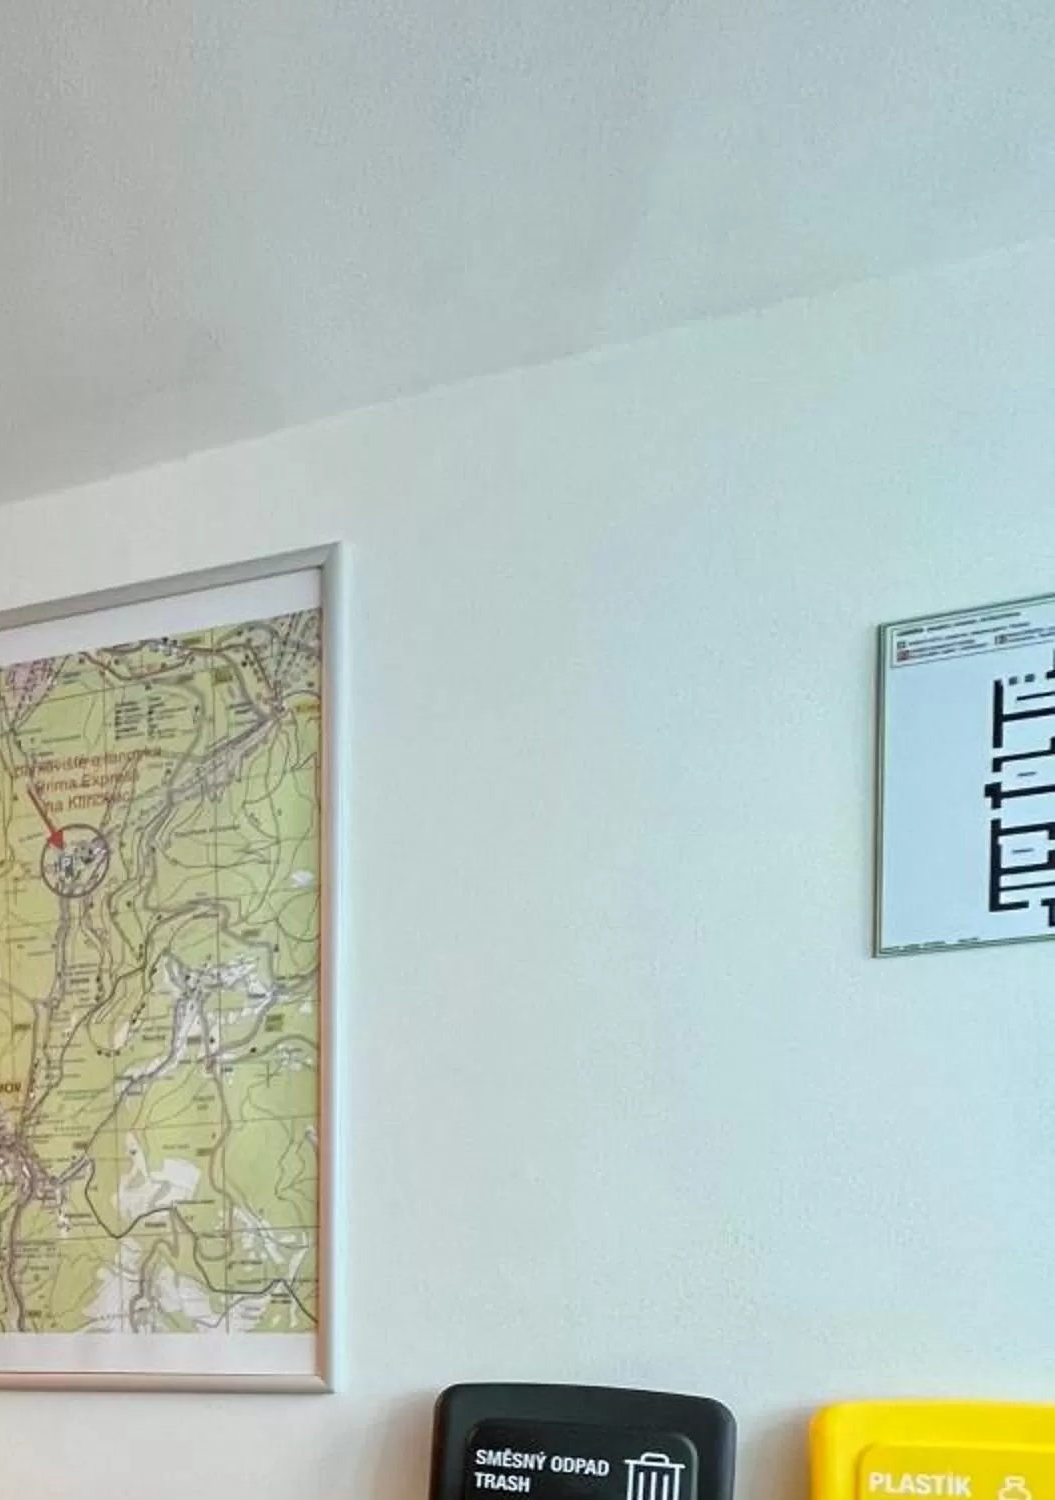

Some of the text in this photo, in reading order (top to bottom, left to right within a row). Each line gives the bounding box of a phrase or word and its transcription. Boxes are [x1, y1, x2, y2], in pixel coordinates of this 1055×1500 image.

[475, 1447, 611, 1477] SMĚSNÝ ODPAD
[474, 1471, 531, 1493] TRASH
[868, 1471, 972, 1498] PLASTIK
